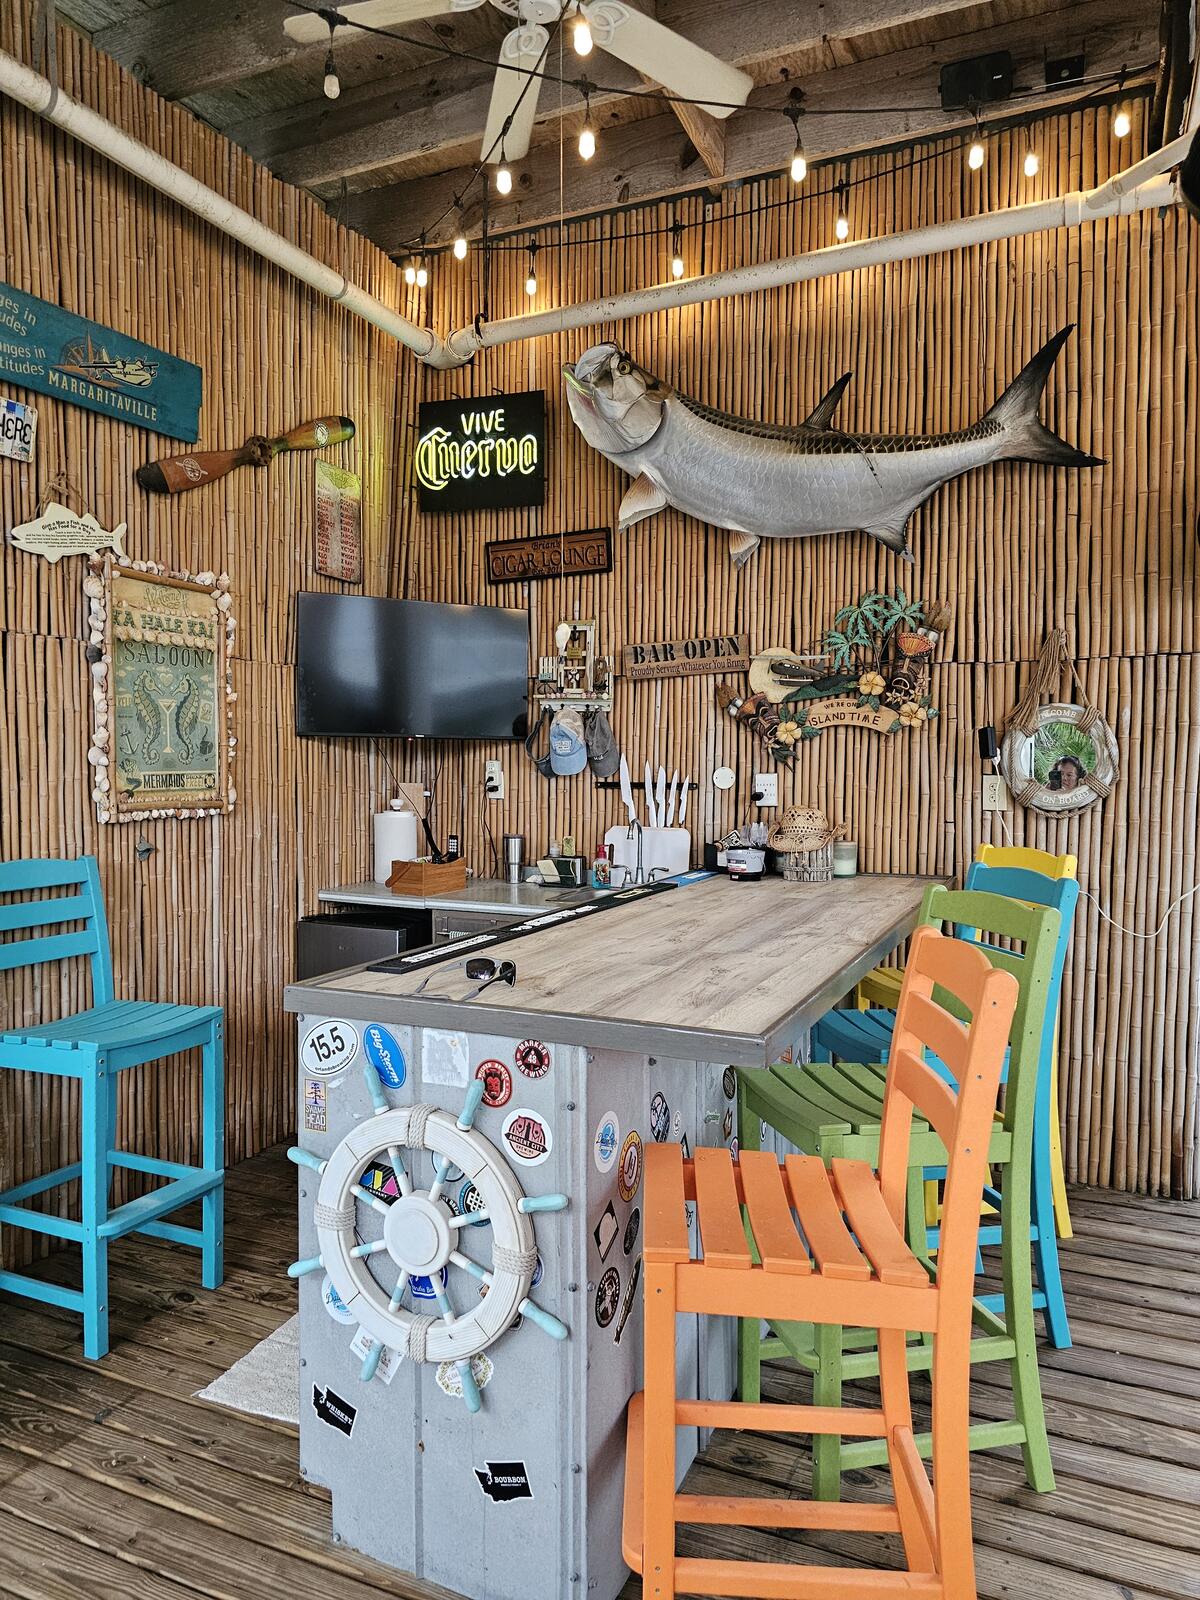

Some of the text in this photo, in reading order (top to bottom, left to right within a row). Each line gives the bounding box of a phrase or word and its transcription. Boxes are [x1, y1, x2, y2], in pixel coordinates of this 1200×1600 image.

[24, 307, 37, 326] in
[34, 345, 46, 359] in
[48, 370, 158, 422] MARGARITAVILLE
[461, 408, 505, 435] VIVE
[415, 426, 538, 490] Cuervo
[492, 544, 606, 577] CIGAR LOUNGE
[124, 641, 205, 669] SALOON
[631, 636, 740, 665] BAR OPEN
[630, 658, 746, 677] Proudly Serving Whatever You Bring
[824, 701, 845, 710] WE'RE
[808, 712, 881, 727] ISLAND TIME
[143, 773, 186, 789] MERMAIDS
[1042, 790, 1090, 804] ON BOARD
[309, 1025, 345, 1063] 15.5
[518, 1039, 548, 1056] MARKER
[527, 1054, 537, 1064] 48
[516, 1060, 548, 1078] BREWING
[508, 1134, 544, 1152] ANCIENT CITY
[493, 1476, 527, 1484] BOURBON
